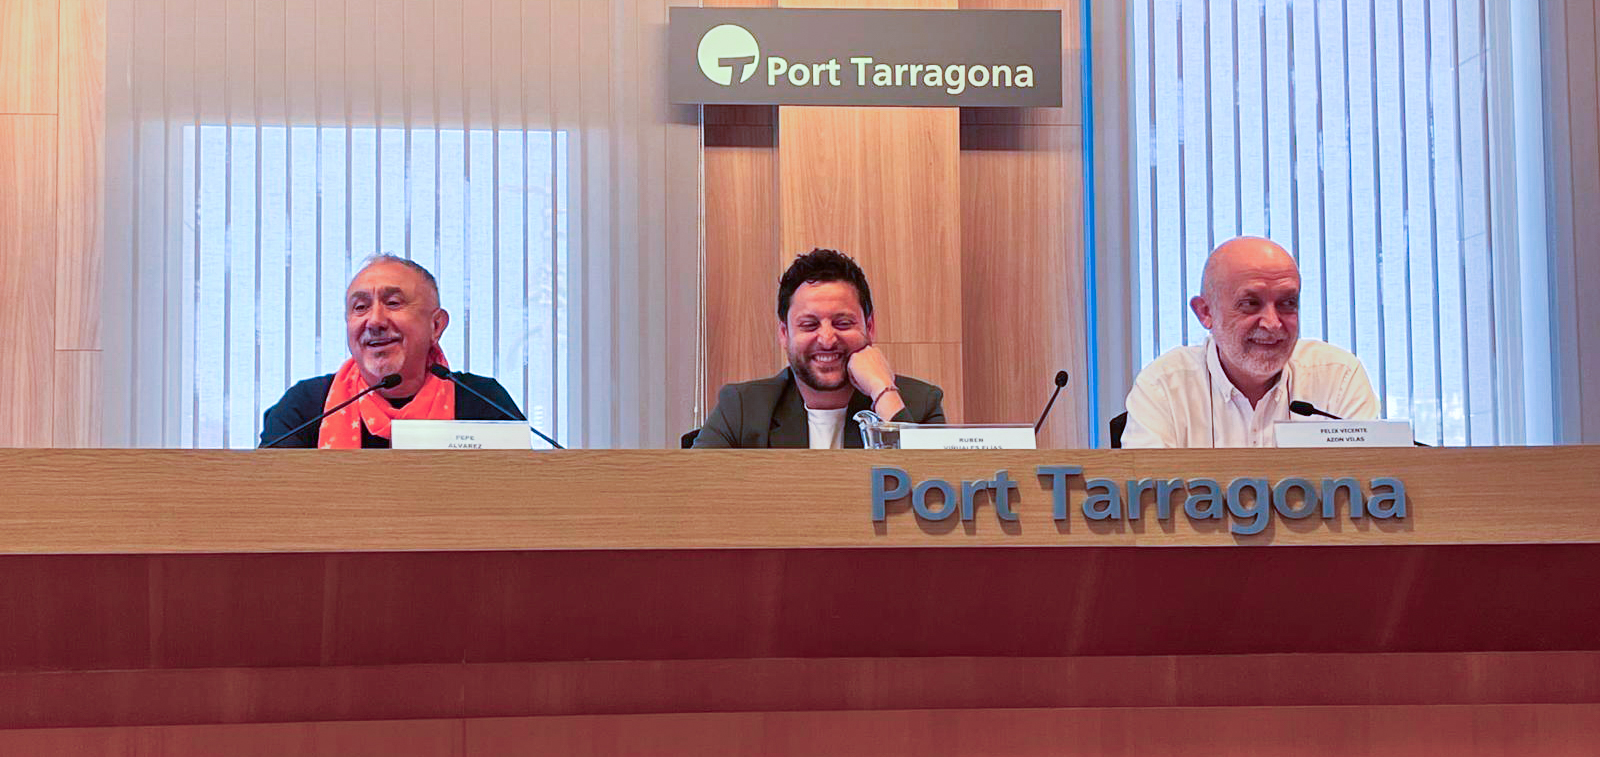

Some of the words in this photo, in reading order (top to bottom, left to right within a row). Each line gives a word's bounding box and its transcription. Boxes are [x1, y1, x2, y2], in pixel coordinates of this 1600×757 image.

[766, 56, 841, 86] Port
[850, 56, 1035, 94] Tarragona
[870, 465, 1020, 523] Port
[1036, 464, 1408, 536] Tarragona
